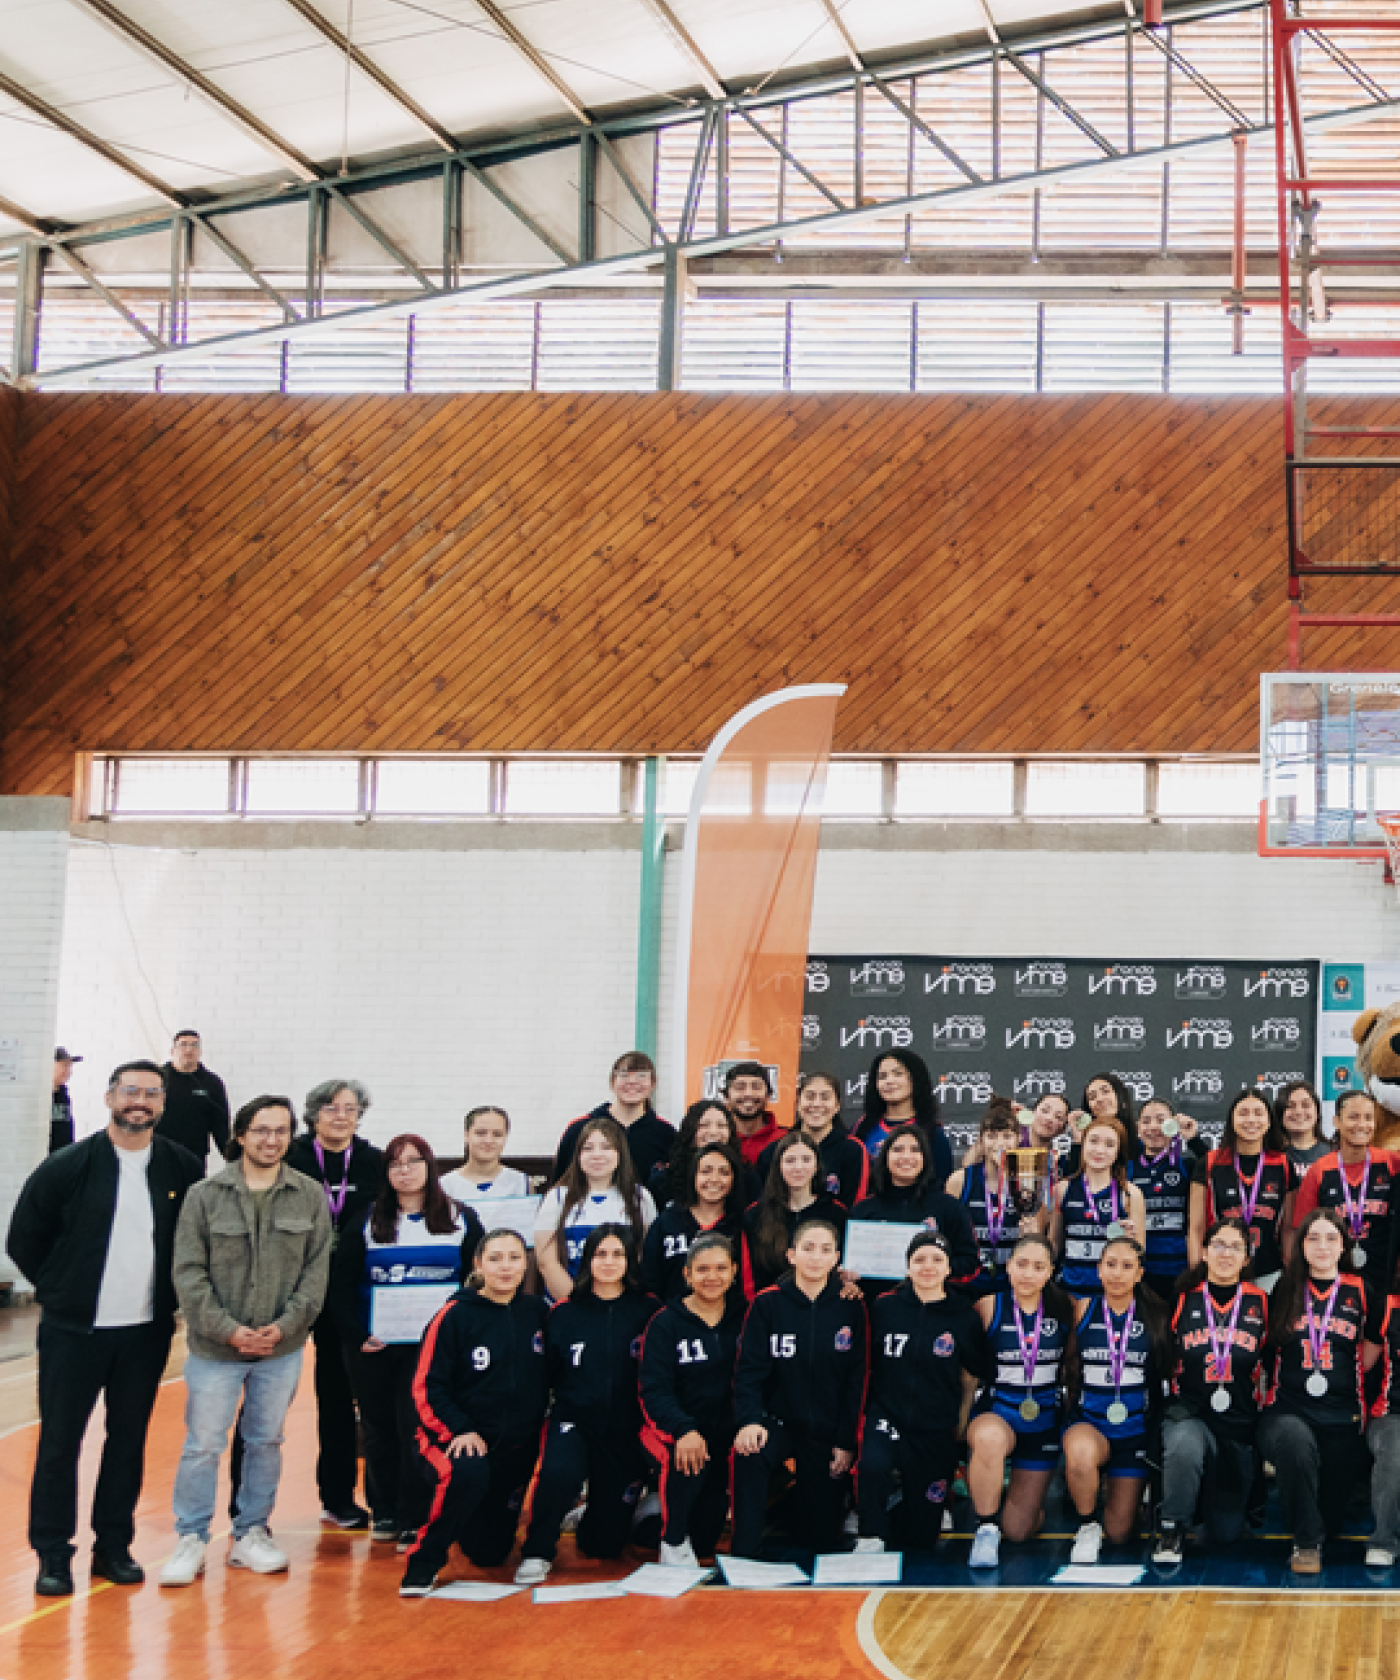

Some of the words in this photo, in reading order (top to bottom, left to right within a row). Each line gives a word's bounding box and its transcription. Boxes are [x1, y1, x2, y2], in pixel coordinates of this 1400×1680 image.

[471, 1345, 491, 1370] 9
[569, 1341, 587, 1367] 7
[677, 1338, 709, 1365] 11
[769, 1334, 797, 1358] 15
[883, 1334, 910, 1358] 17
[1301, 1339, 1334, 1370] 14
